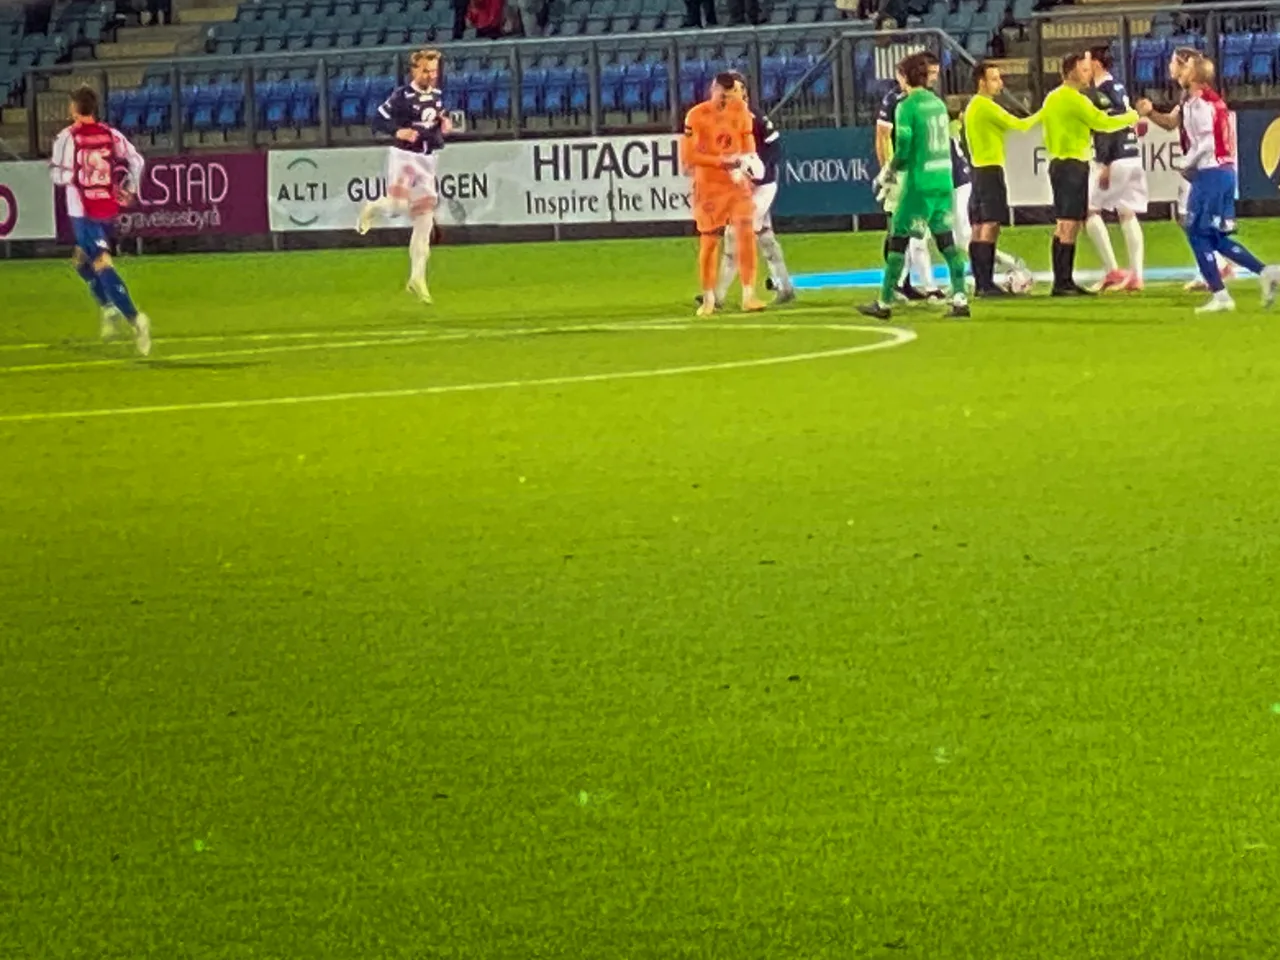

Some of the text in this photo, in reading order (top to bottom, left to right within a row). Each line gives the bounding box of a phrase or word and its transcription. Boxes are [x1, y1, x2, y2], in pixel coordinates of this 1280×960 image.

[533, 140, 679, 181] HITACH
[784, 157, 870, 184] NORDVIK
[276, 182, 328, 201] ALTI
[526, 186, 692, 219] Inspire the Nex
